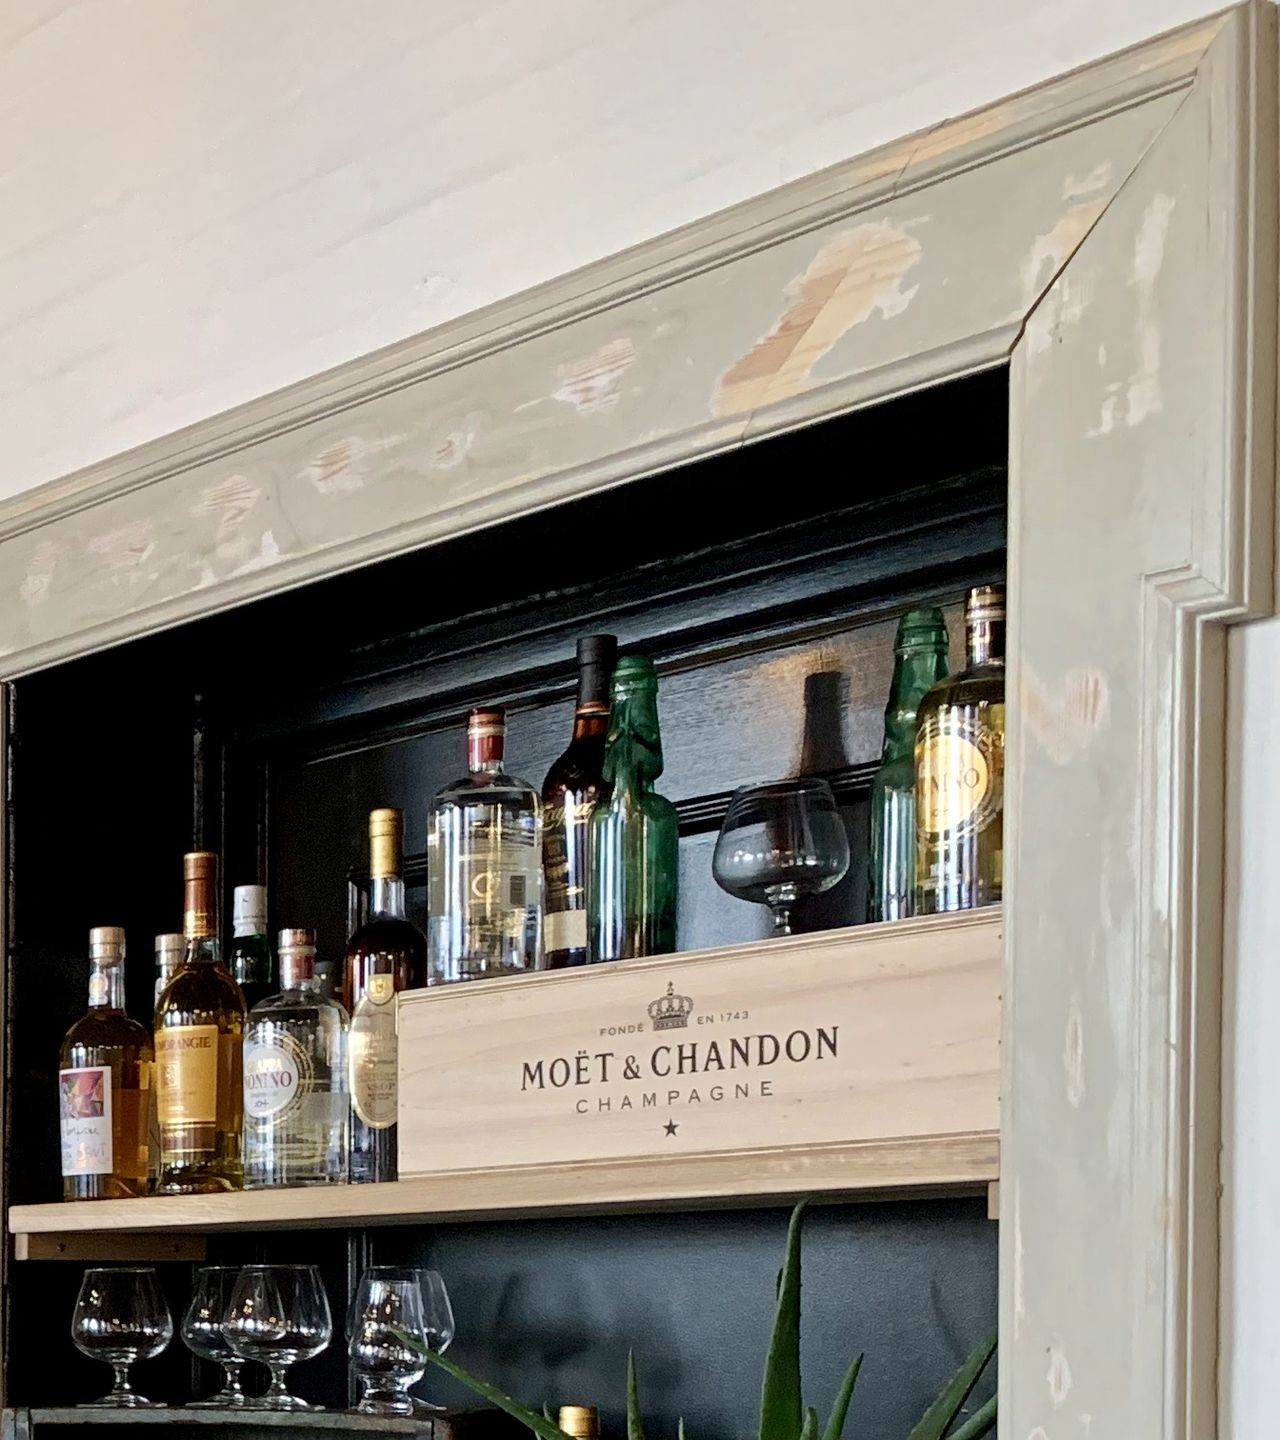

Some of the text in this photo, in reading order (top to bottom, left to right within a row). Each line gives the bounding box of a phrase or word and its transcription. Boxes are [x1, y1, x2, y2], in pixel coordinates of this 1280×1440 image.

[697, 1014, 714, 1025] EN
[719, 1010, 750, 1023] 1743
[520, 1025, 840, 1092] MOËT & CHANDON
[575, 1080, 774, 1114] CHAMPAGNE
